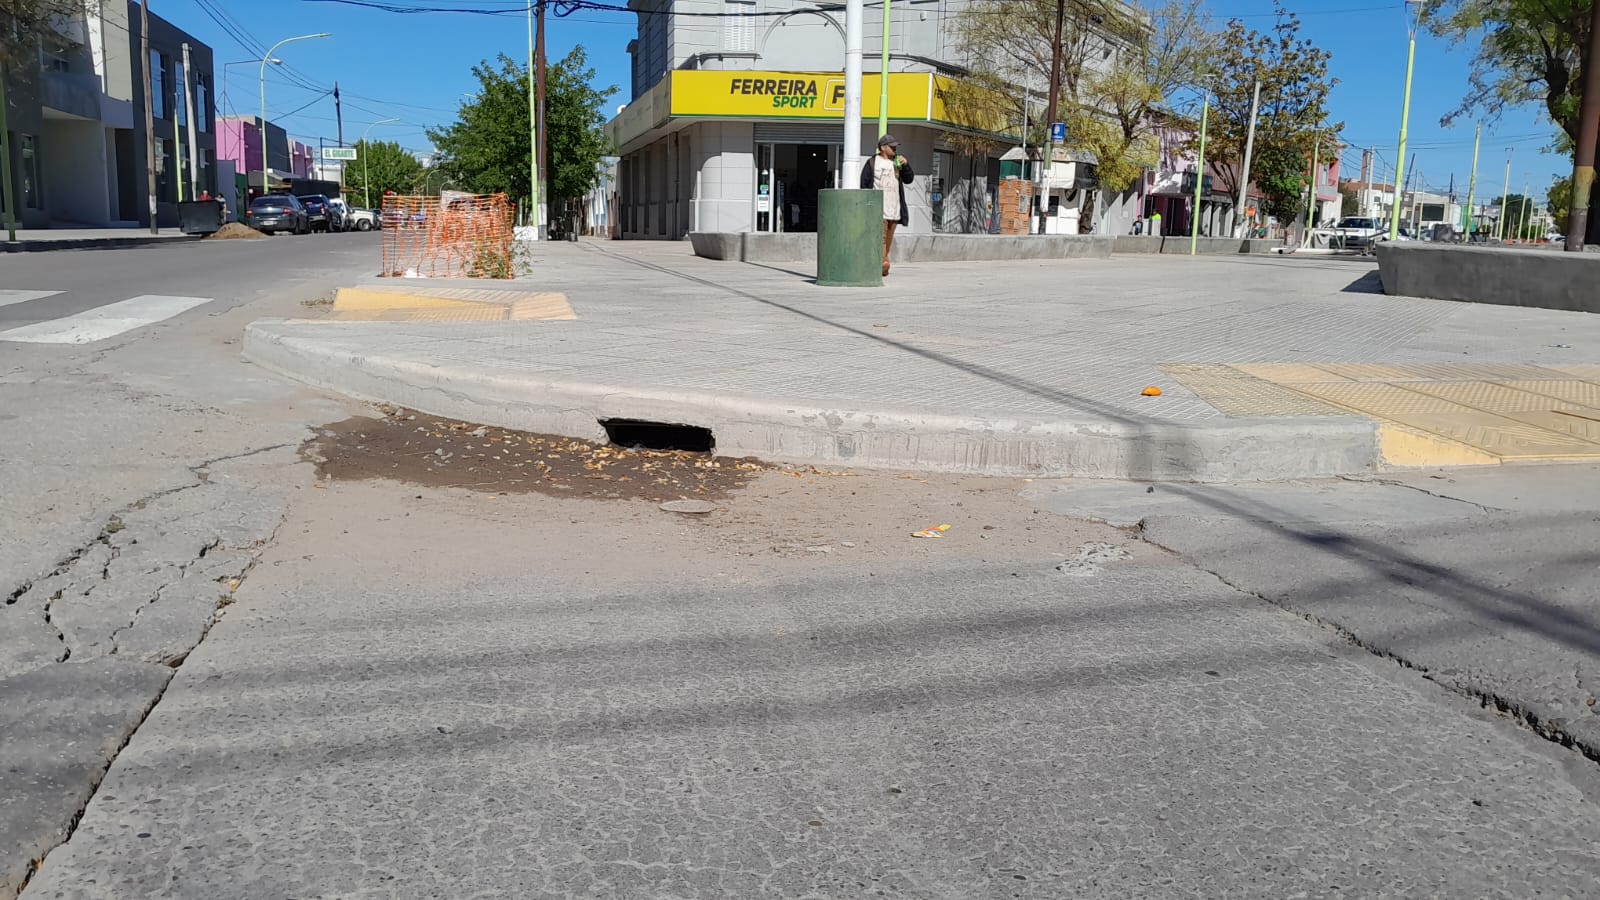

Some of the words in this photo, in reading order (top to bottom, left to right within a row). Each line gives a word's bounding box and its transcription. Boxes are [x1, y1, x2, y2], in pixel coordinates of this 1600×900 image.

[730, 79, 817, 95] FERREIRA
[773, 96, 817, 108] SPORT
[324, 149, 331, 157] EL
[332, 149, 354, 157] GIGANTE
